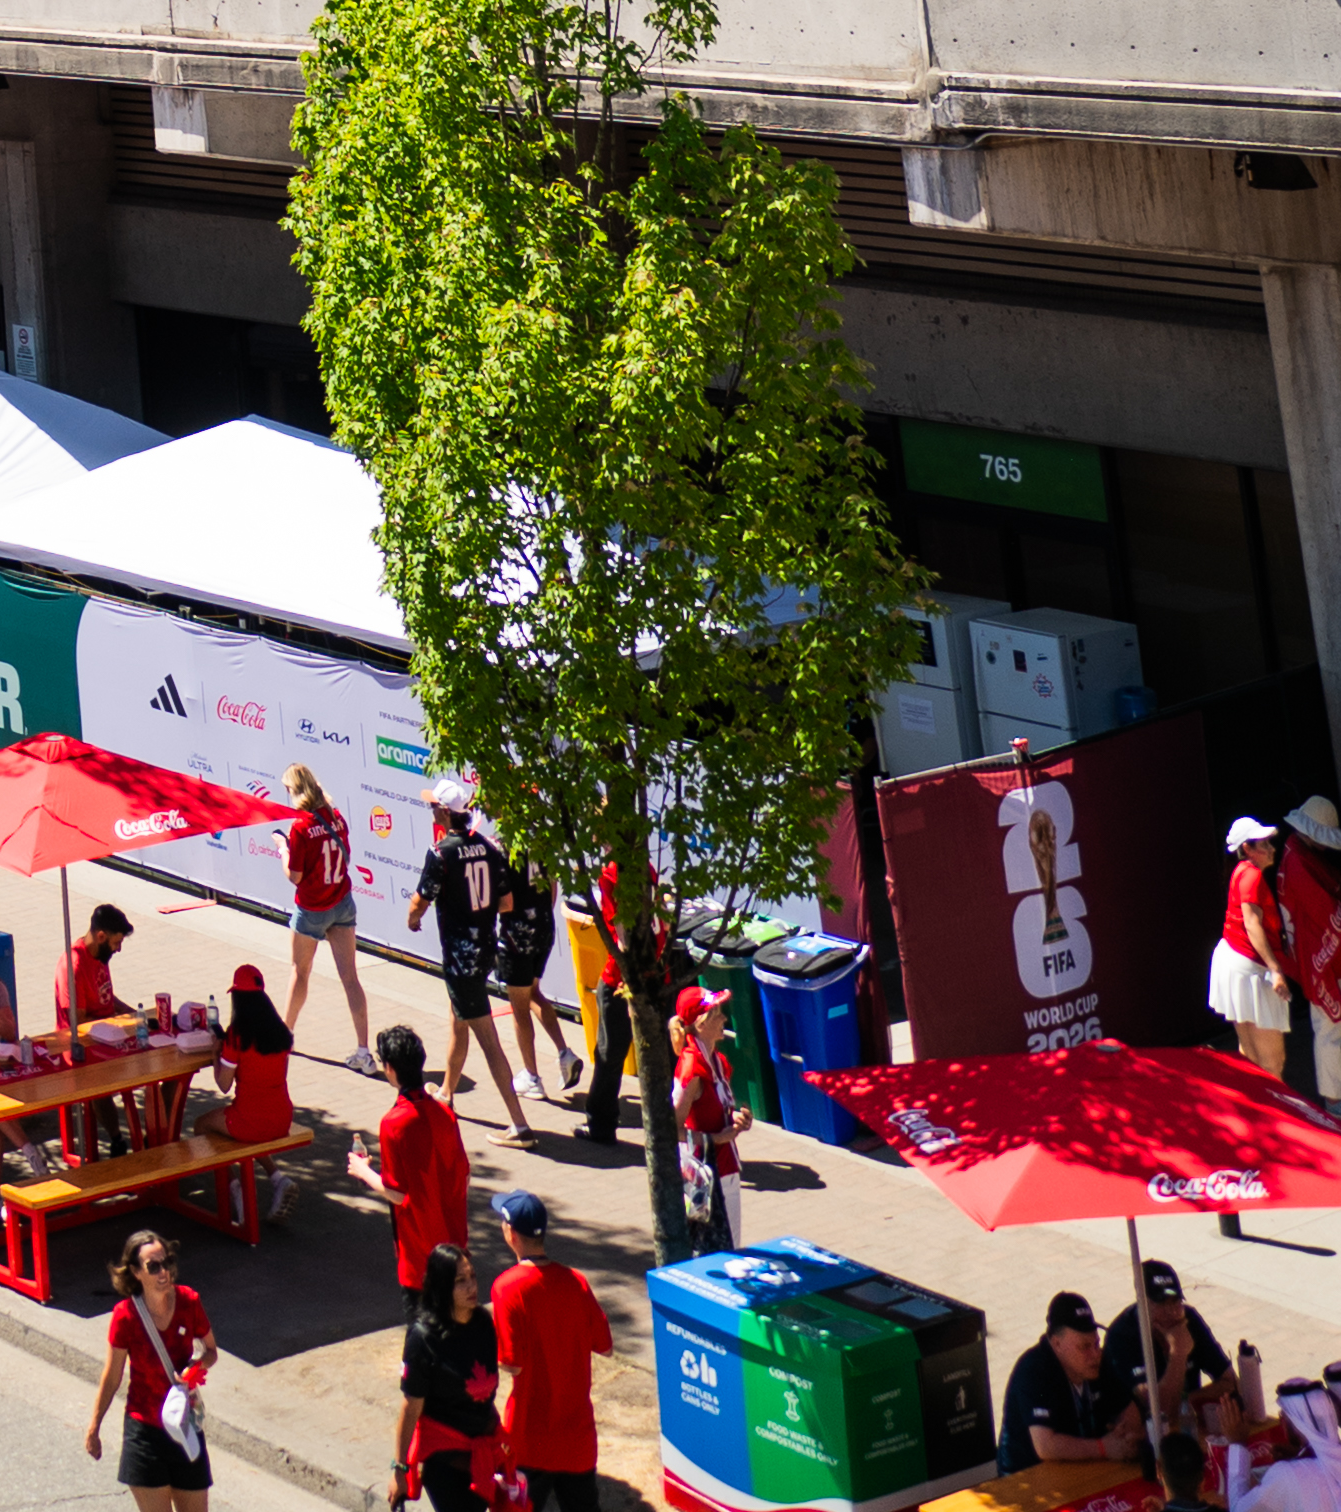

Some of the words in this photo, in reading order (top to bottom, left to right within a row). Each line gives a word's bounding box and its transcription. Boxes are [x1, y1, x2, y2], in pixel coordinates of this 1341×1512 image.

[979, 453, 1022, 483] 765
[216, 694, 267, 731] Coca-Cola
[322, 729, 350, 746] KIA
[187, 758, 214, 774] ULTRA
[360, 783, 374, 793] FIFA
[374, 785, 394, 800] WORLD
[395, 790, 408, 802] CUP
[114, 808, 190, 841] Coca-Cola
[371, 813, 392, 832] Lay's
[364, 850, 377, 861] FIFA
[378, 853, 398, 867] WORLD
[399, 858, 412, 871] CUP
[464, 860, 491, 912] 10
[1042, 948, 1076, 978] FIFA
[1024, 1000, 1075, 1030] WORLD
[1076, 992, 1099, 1018] CUP
[1026, 1016, 1103, 1054] 2026
[888, 1107, 963, 1155] Coca-Cola
[1147, 1168, 1270, 1204] Coca-Cola
[666, 1321, 727, 1356] REFUNDABLES
[681, 1381, 713, 1402] BOTTLES
[713, 1395, 719, 1406] &
[769, 1366, 814, 1392] COMPOST
[681, 1392, 700, 1410] CANS
[700, 1399, 720, 1416] ONLY
[871, 1388, 901, 1405] COMPOST
[755, 1426, 817, 1461] COMPOSTABLES
[817, 1448, 839, 1467] ONLY
[767, 1419, 790, 1436] FOOD
[790, 1426, 817, 1449] WASTE
